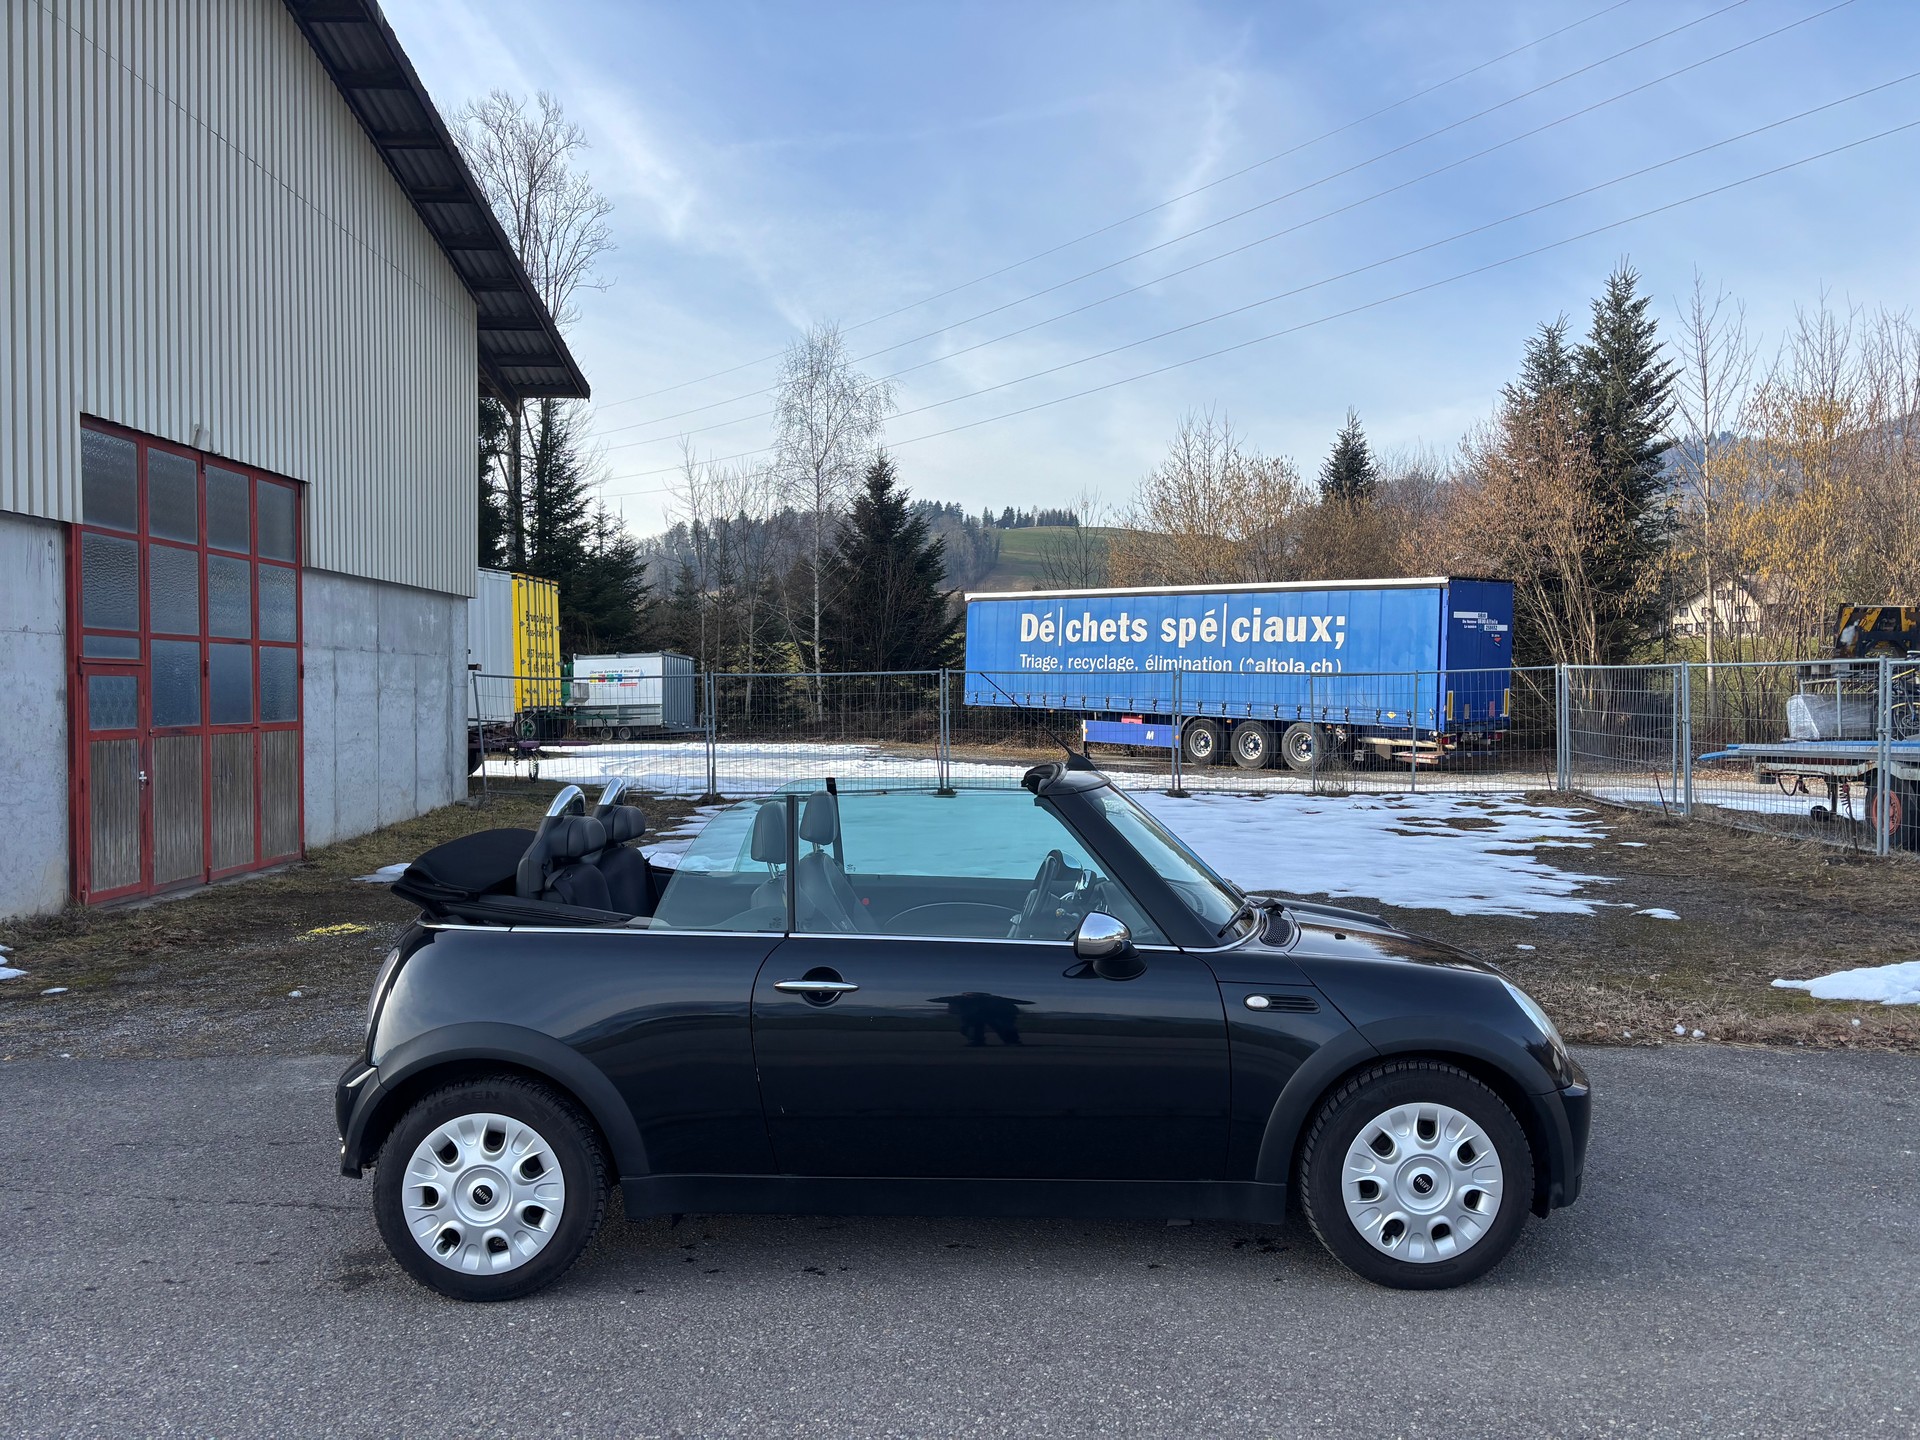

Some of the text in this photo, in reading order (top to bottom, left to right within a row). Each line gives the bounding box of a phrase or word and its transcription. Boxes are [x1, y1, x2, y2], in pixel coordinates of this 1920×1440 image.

[1020, 653, 1063, 672] Triage,
[1068, 654, 1139, 672] recyclage,
[1145, 654, 1233, 672] élimination
[1415, 1176, 1431, 1191] MINI
[475, 1187, 491, 1203] MINI
